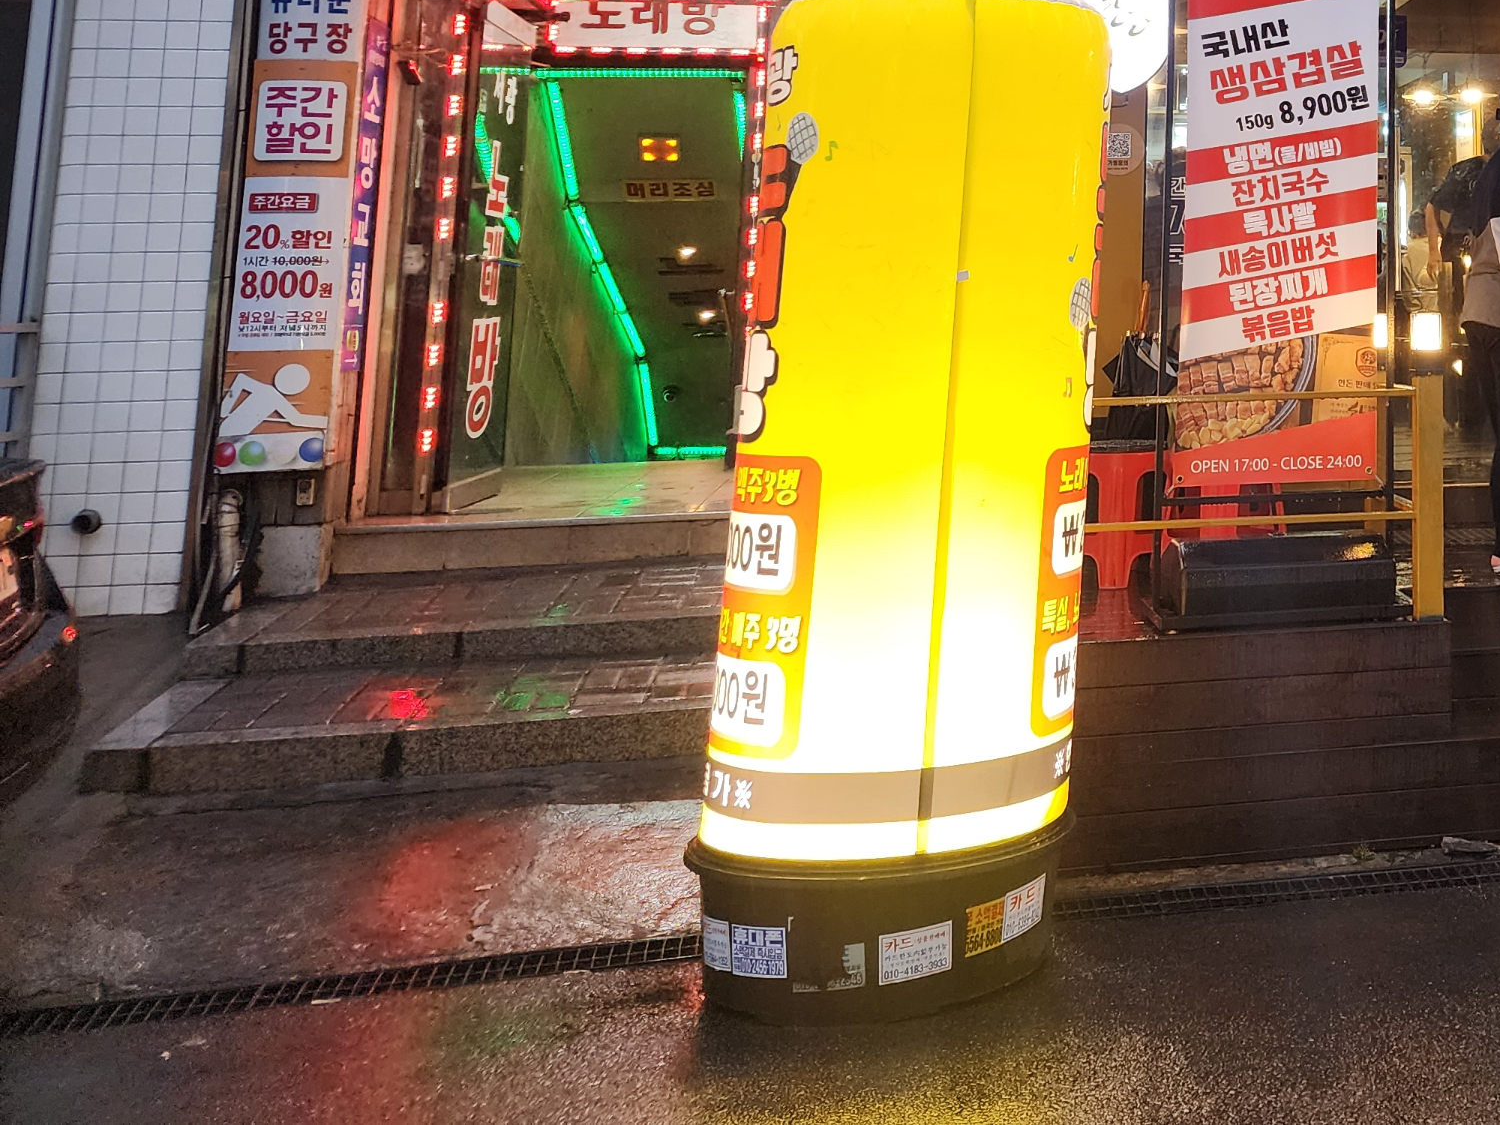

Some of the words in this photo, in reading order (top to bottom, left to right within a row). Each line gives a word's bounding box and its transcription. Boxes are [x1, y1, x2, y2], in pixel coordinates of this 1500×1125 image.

[580, 0, 725, 35] 노래방
[268, 22, 352, 54] 당구장
[1201, 18, 1290, 58] 국내산
[1210, 41, 1365, 105] 생삼겹살
[265, 86, 338, 118] 주간
[1235, 113, 1274, 132] 150g
[1279, 85, 1370, 126] 8,900원
[265, 121, 334, 154] 할인
[1223, 137, 1342, 175] 냉면(물/비빔)
[253, 195, 312, 209] 주간요금
[625, 181, 716, 199] 머리조심
[1231, 168, 1330, 208] 잔치국수
[1243, 201, 1317, 238] 묵사발
[243, 256, 269, 267] 1시간
[1218, 231, 1339, 279] 새송이버섯
[240, 270, 333, 302] 8,000원
[1229, 266, 1328, 312] 된장찌개
[1241, 304, 1315, 343] 볶음밥
[1190, 459, 1231, 474] OPEN
[1233, 457, 1270, 472] 17:00
[1281, 456, 1324, 471] CLOSE
[1327, 455, 1362, 469] 24:00
[734, 928, 783, 947] 휴대폰
[884, 936, 914, 953] 카드
[884, 957, 948, 980] 010-4183-3933
